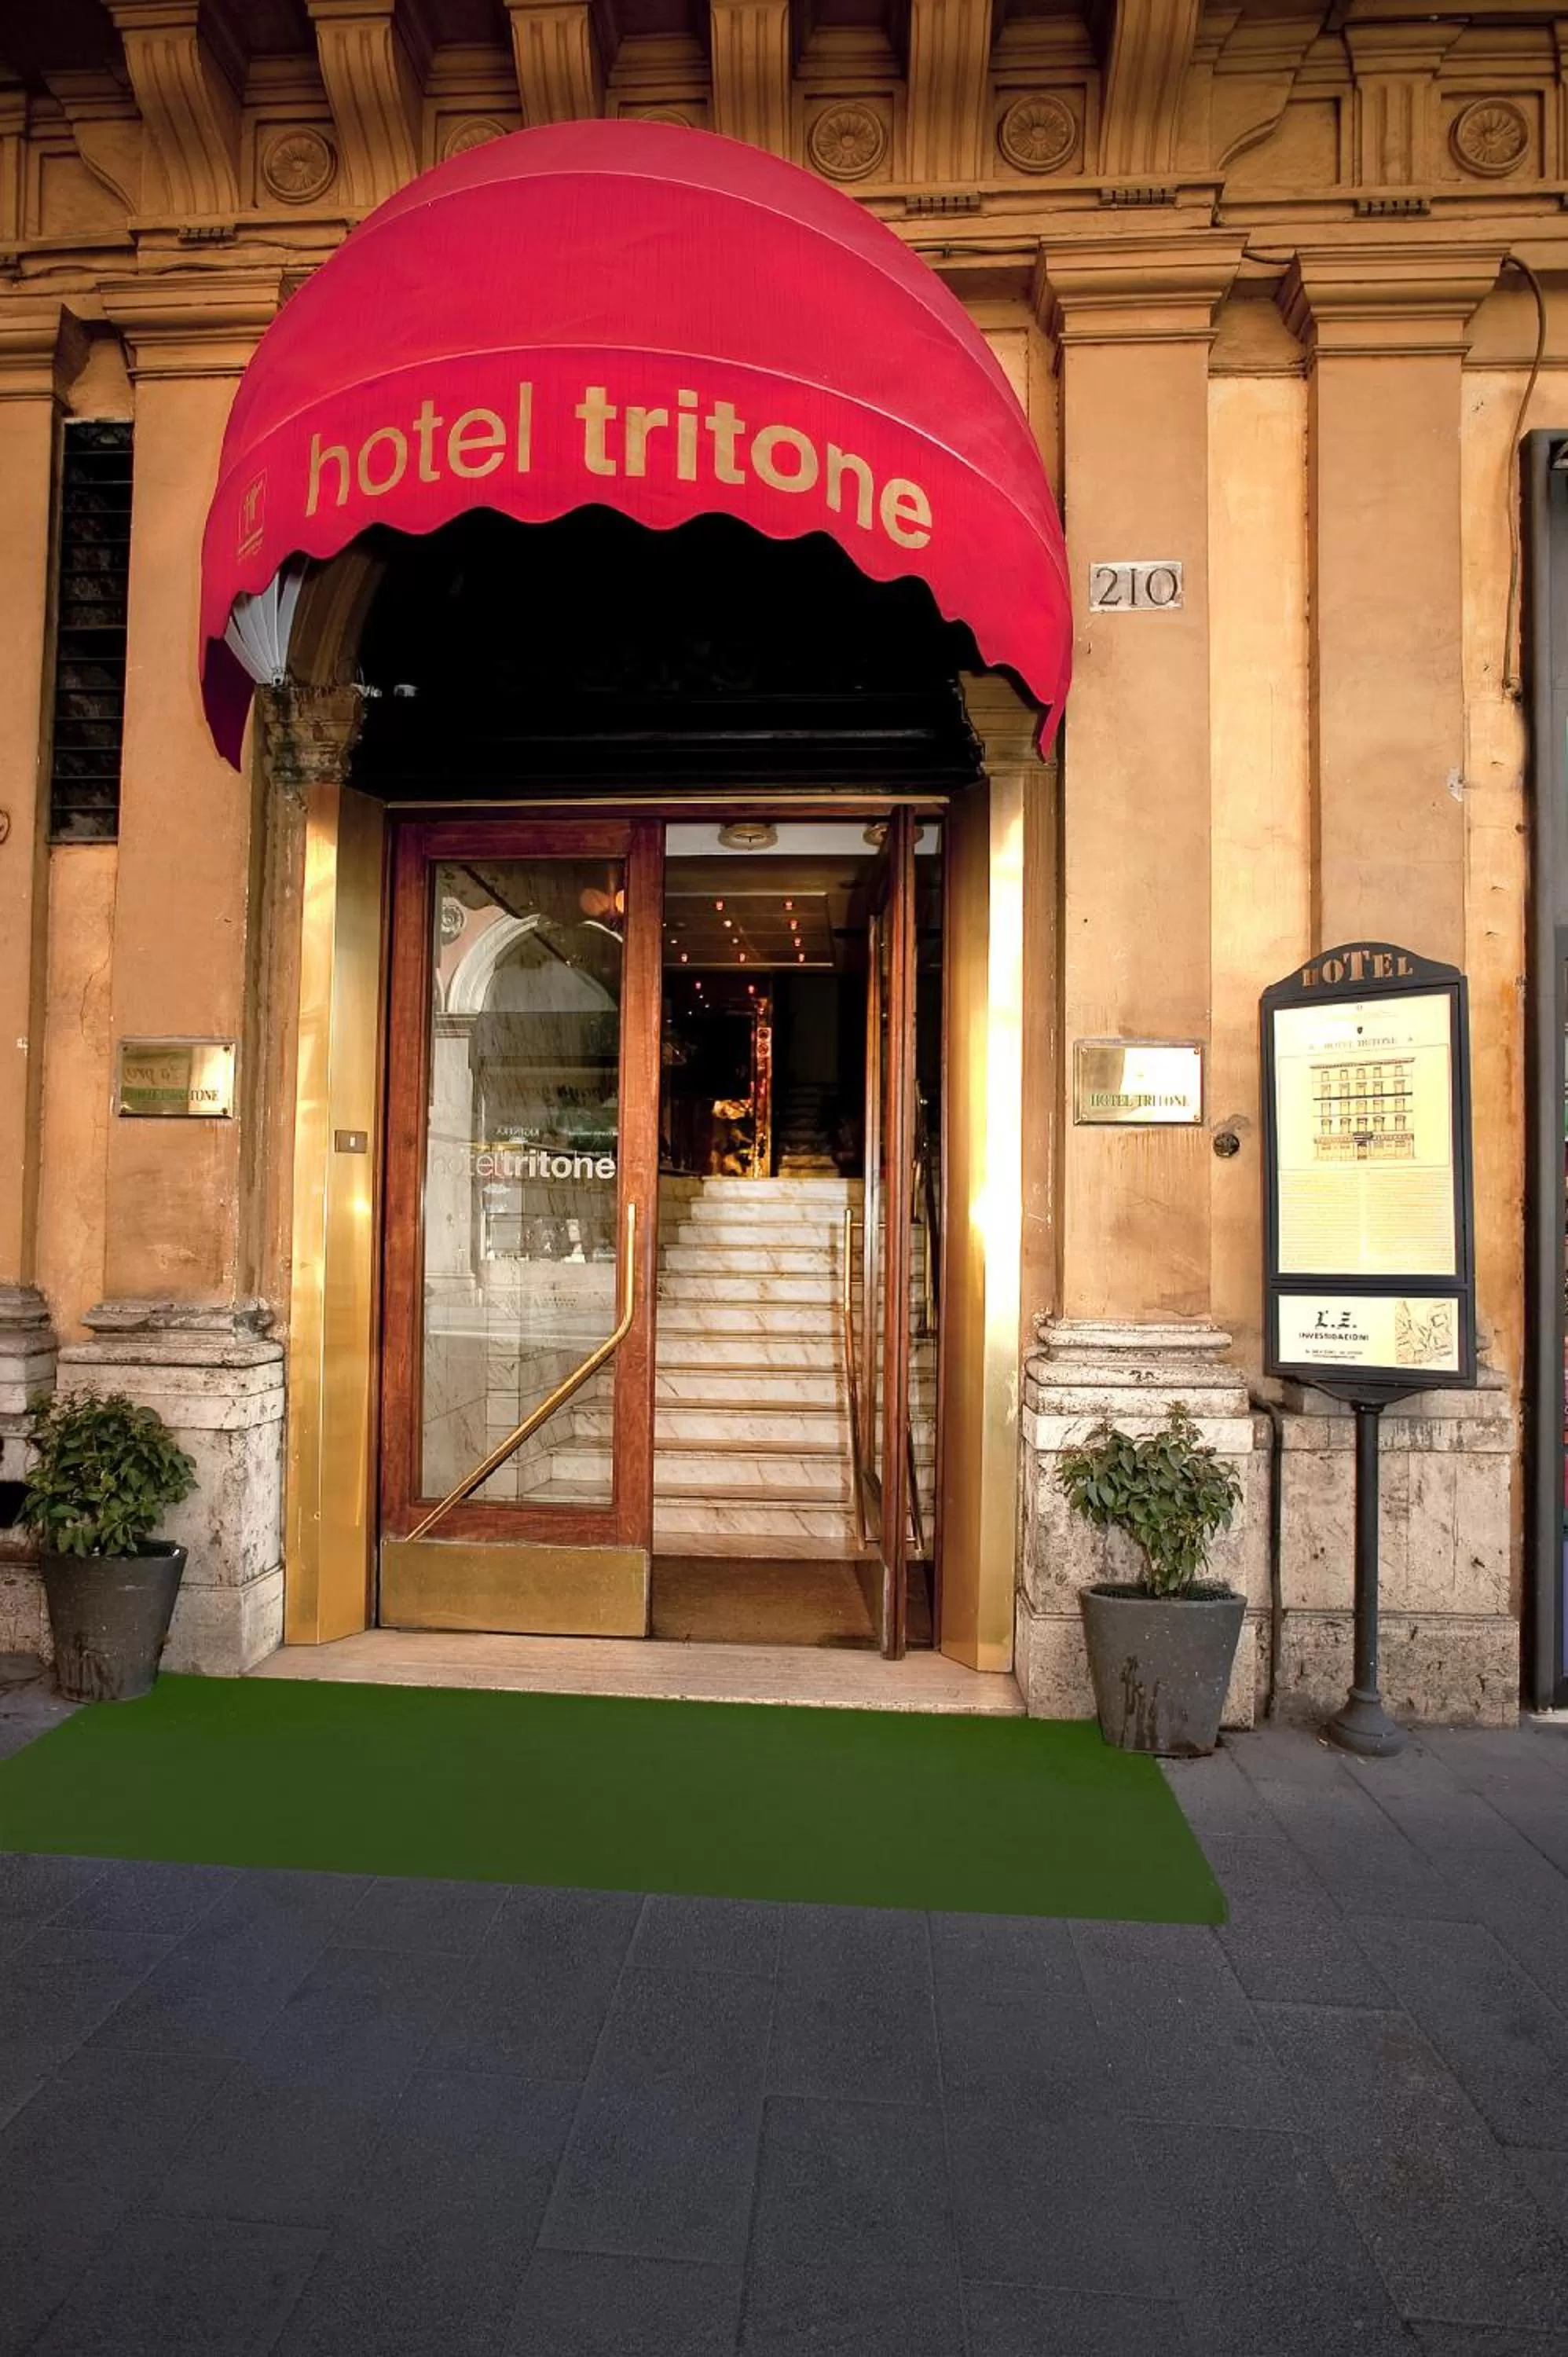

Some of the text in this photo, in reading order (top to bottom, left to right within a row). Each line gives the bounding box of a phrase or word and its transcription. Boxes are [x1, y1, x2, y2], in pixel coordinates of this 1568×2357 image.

[305, 381, 533, 517] hotel
[574, 386, 934, 549] tritone
[1096, 567, 1178, 606] 210
[1301, 950, 1413, 988] HOTEL
[1090, 1093, 1133, 1107] HOTEL
